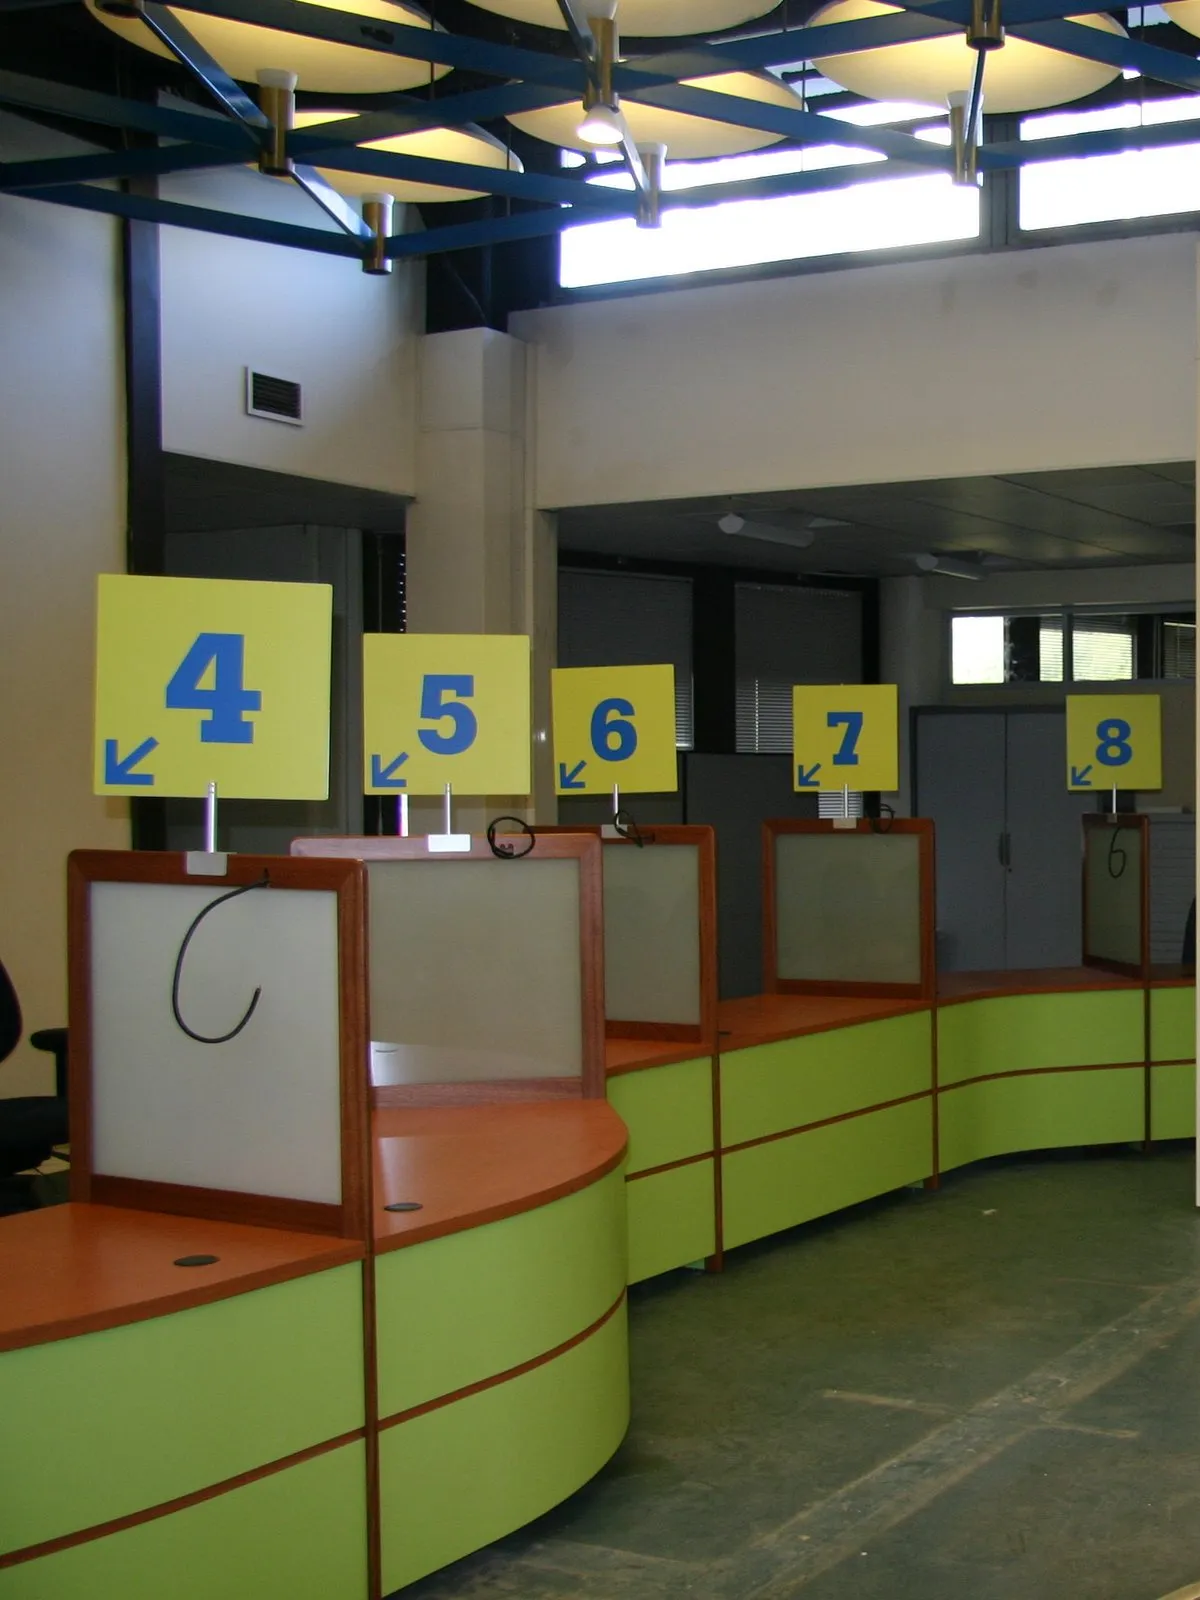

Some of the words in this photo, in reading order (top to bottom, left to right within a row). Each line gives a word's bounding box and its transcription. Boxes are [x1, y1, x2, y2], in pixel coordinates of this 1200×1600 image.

[165, 633, 261, 744] 4
[417, 674, 476, 755] 5
[591, 699, 636, 761] 6
[828, 712, 863, 765] 7
[1096, 719, 1132, 766] 8
